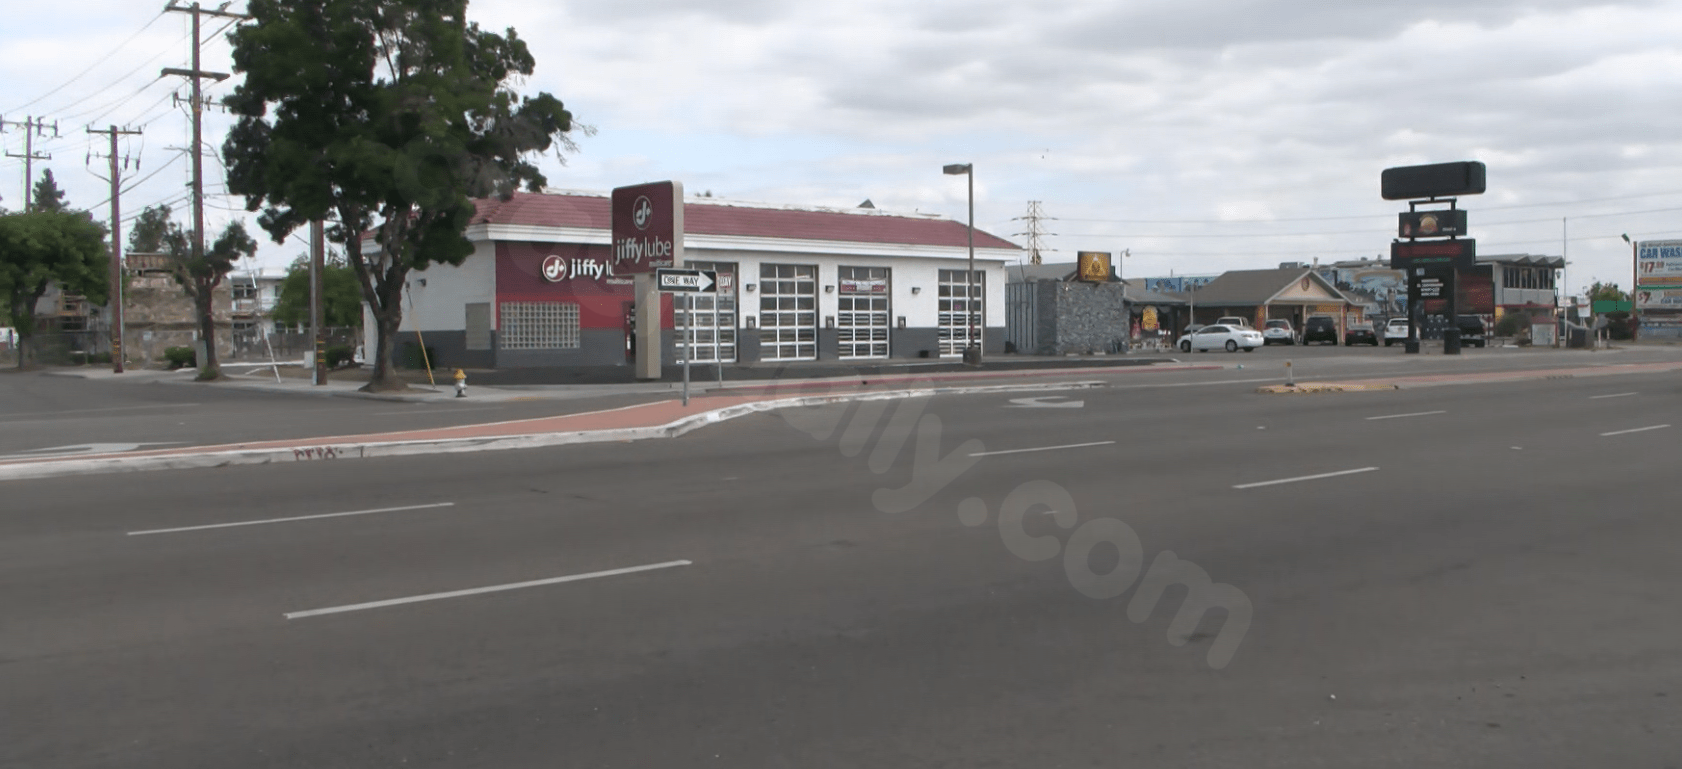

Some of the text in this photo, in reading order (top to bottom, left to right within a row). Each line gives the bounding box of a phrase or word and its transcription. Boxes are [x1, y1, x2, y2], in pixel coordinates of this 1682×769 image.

[615, 235, 672, 265] jiffy lube
[1640, 248, 1658, 259] CAR
[569, 258, 604, 280] jiffy
[663, 275, 699, 286] ONE WAY
